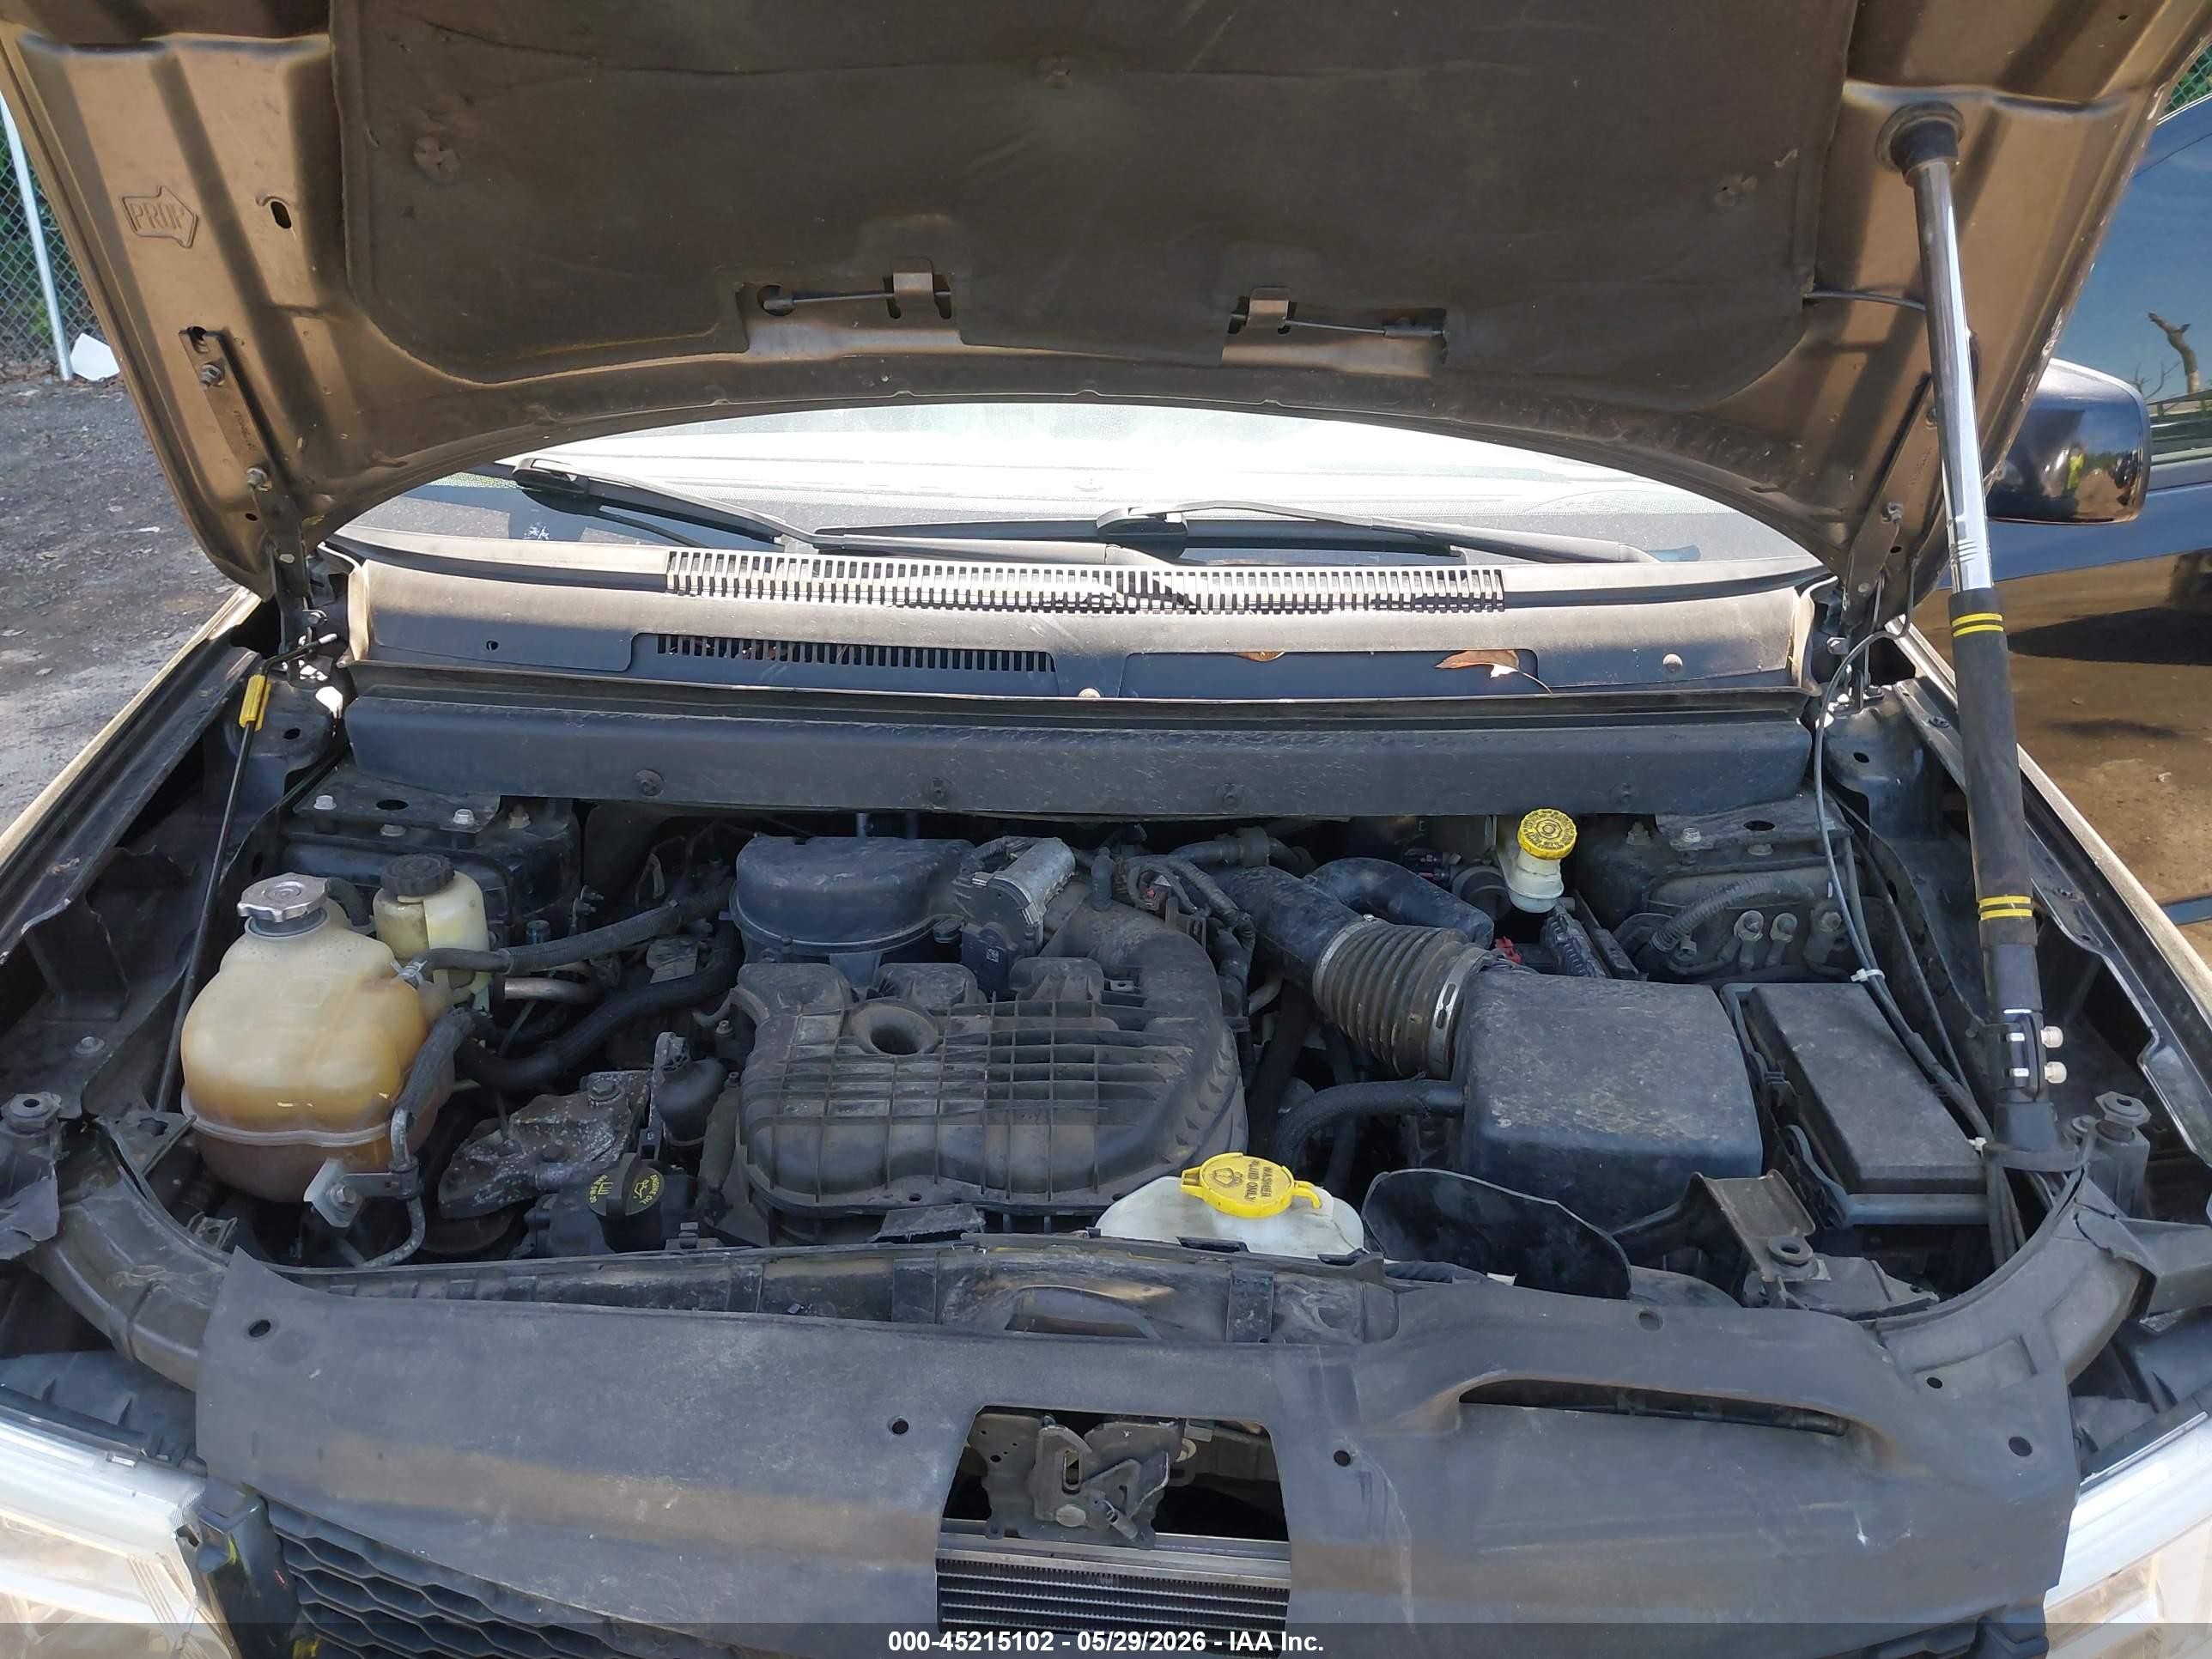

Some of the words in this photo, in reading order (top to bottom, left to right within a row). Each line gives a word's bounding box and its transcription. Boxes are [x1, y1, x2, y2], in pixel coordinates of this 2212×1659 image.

[130, 203, 185, 229] PROP
[1248, 1160, 1260, 1181] FLUID
[649, 1175, 659, 1195] ENGINE
[1261, 1166, 1273, 1197] WASHER
[640, 1194, 653, 1204] OIL
[1244, 1182, 1258, 1202] ONLY
